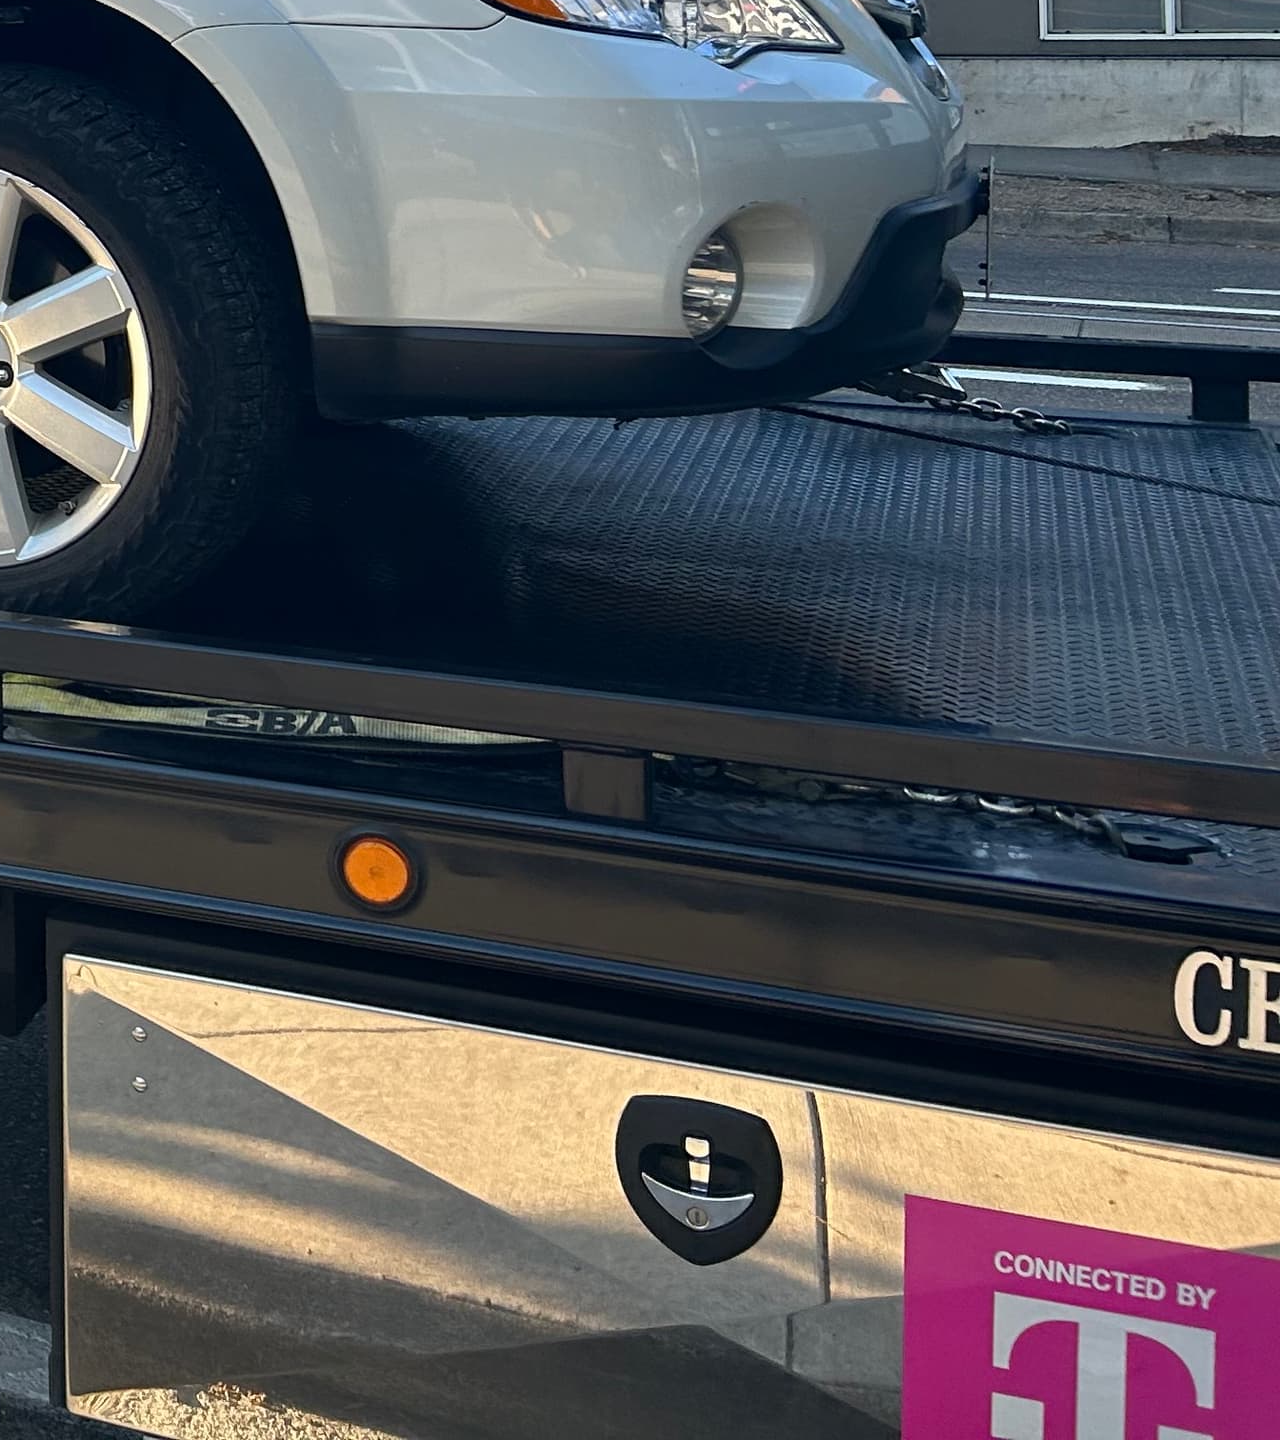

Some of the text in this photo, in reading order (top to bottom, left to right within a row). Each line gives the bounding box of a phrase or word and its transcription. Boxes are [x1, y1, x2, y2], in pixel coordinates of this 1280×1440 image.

[993, 1250, 1217, 1311] CONNECTED BY
[991, 1290, 1217, 1440] T
